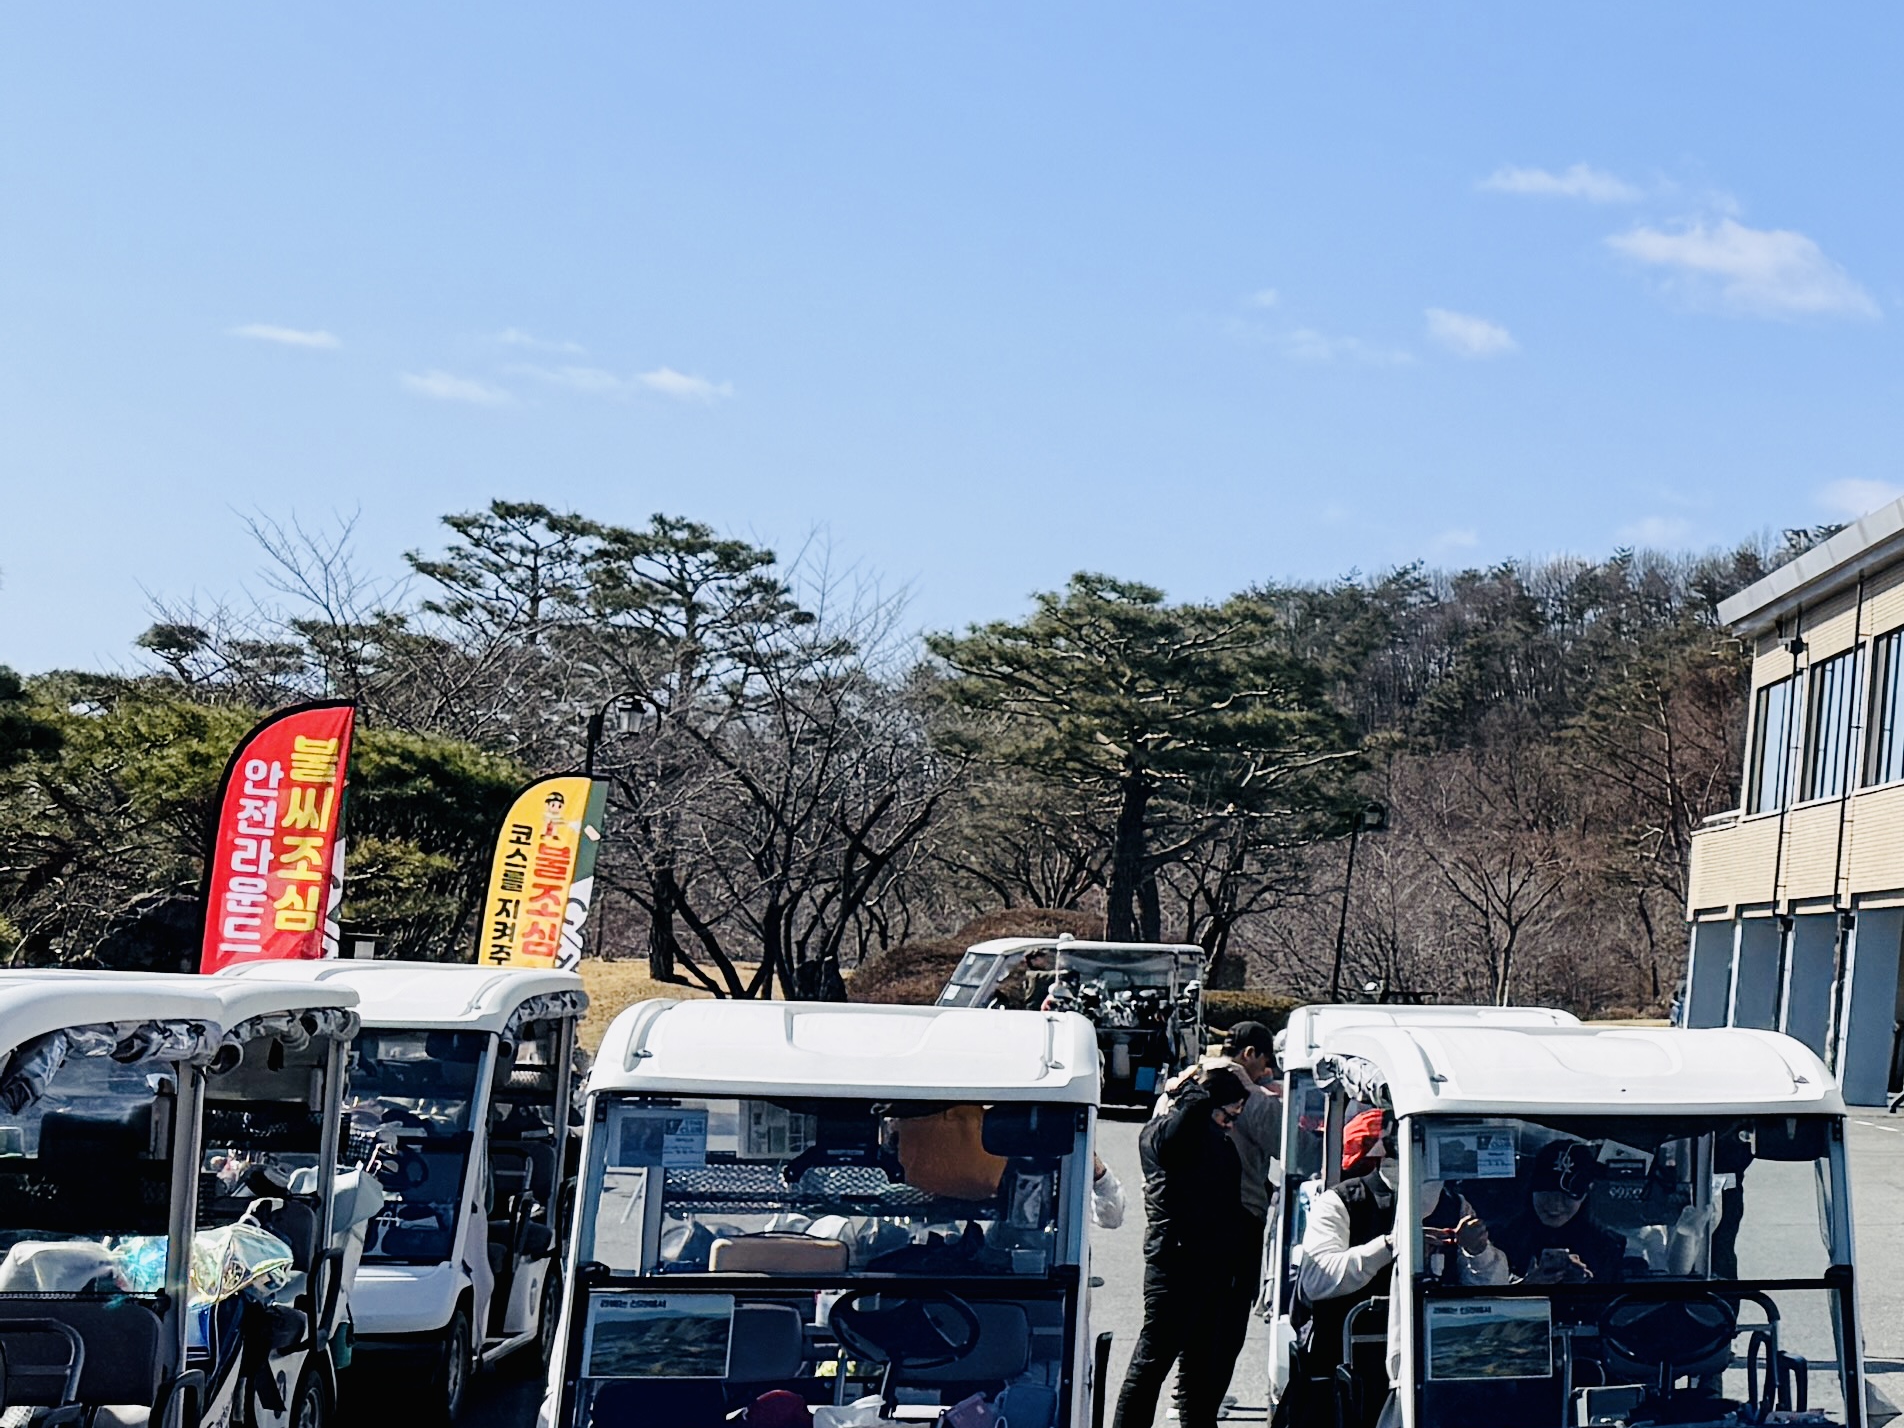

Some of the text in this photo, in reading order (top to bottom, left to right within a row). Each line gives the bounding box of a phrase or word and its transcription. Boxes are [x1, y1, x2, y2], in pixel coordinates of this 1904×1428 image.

[219, 759, 285, 953] 안전라운드
[273, 735, 339, 932] 불씨조심
[500, 823, 533, 893] 코스를
[520, 842, 571, 957] 불조심
